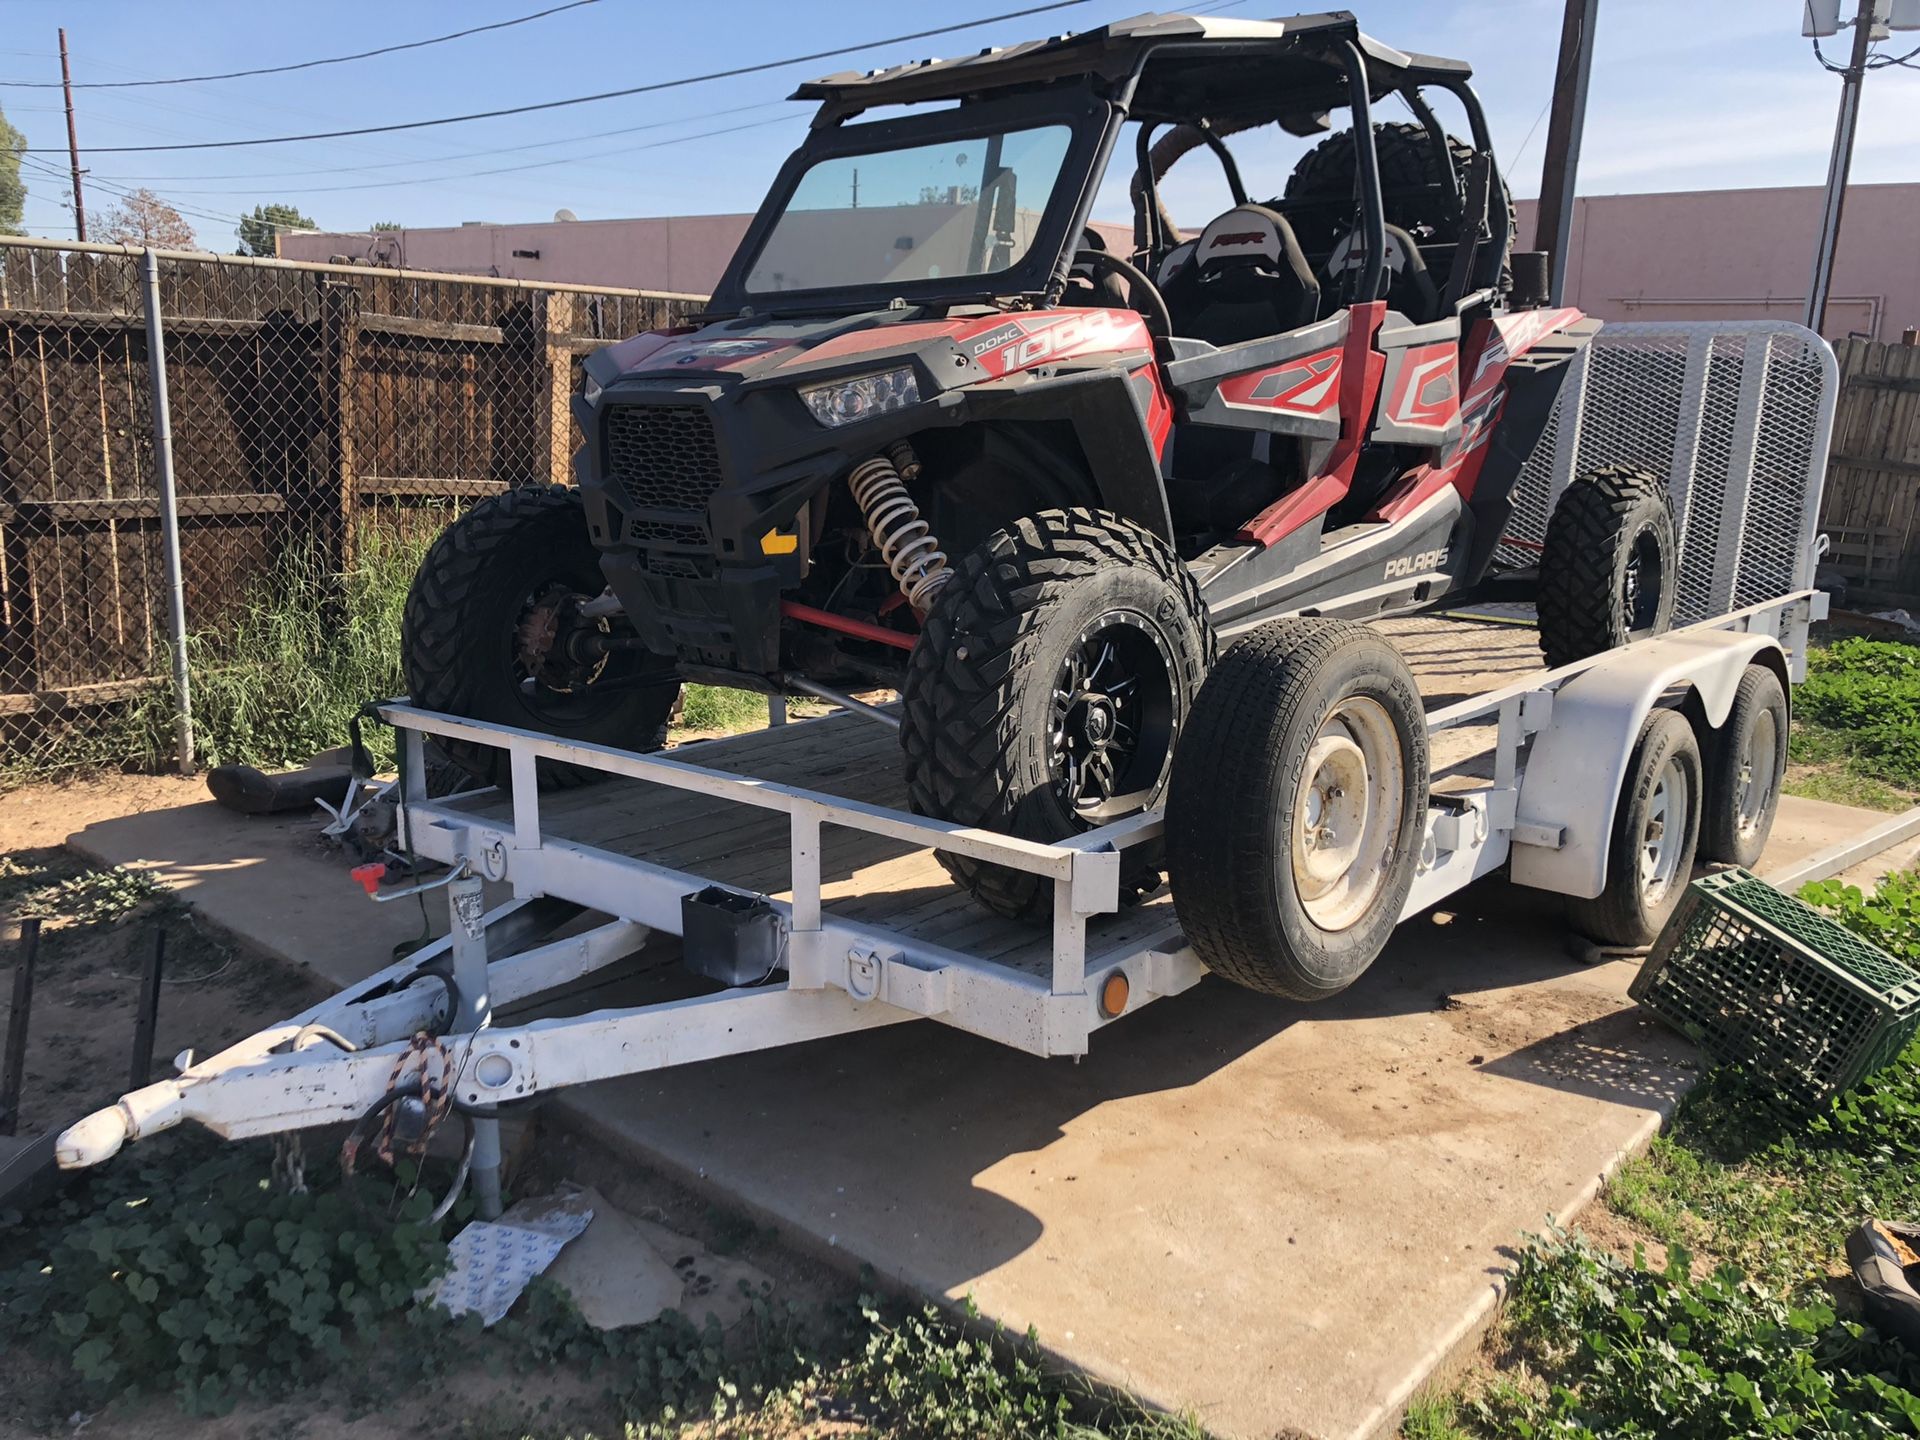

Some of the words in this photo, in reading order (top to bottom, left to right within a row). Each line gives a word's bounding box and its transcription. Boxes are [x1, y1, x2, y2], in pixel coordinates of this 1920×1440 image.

[973, 326, 1019, 356] DOHC
[1001, 310, 1112, 373] 1000
[1383, 546, 1449, 580] POLARIS
